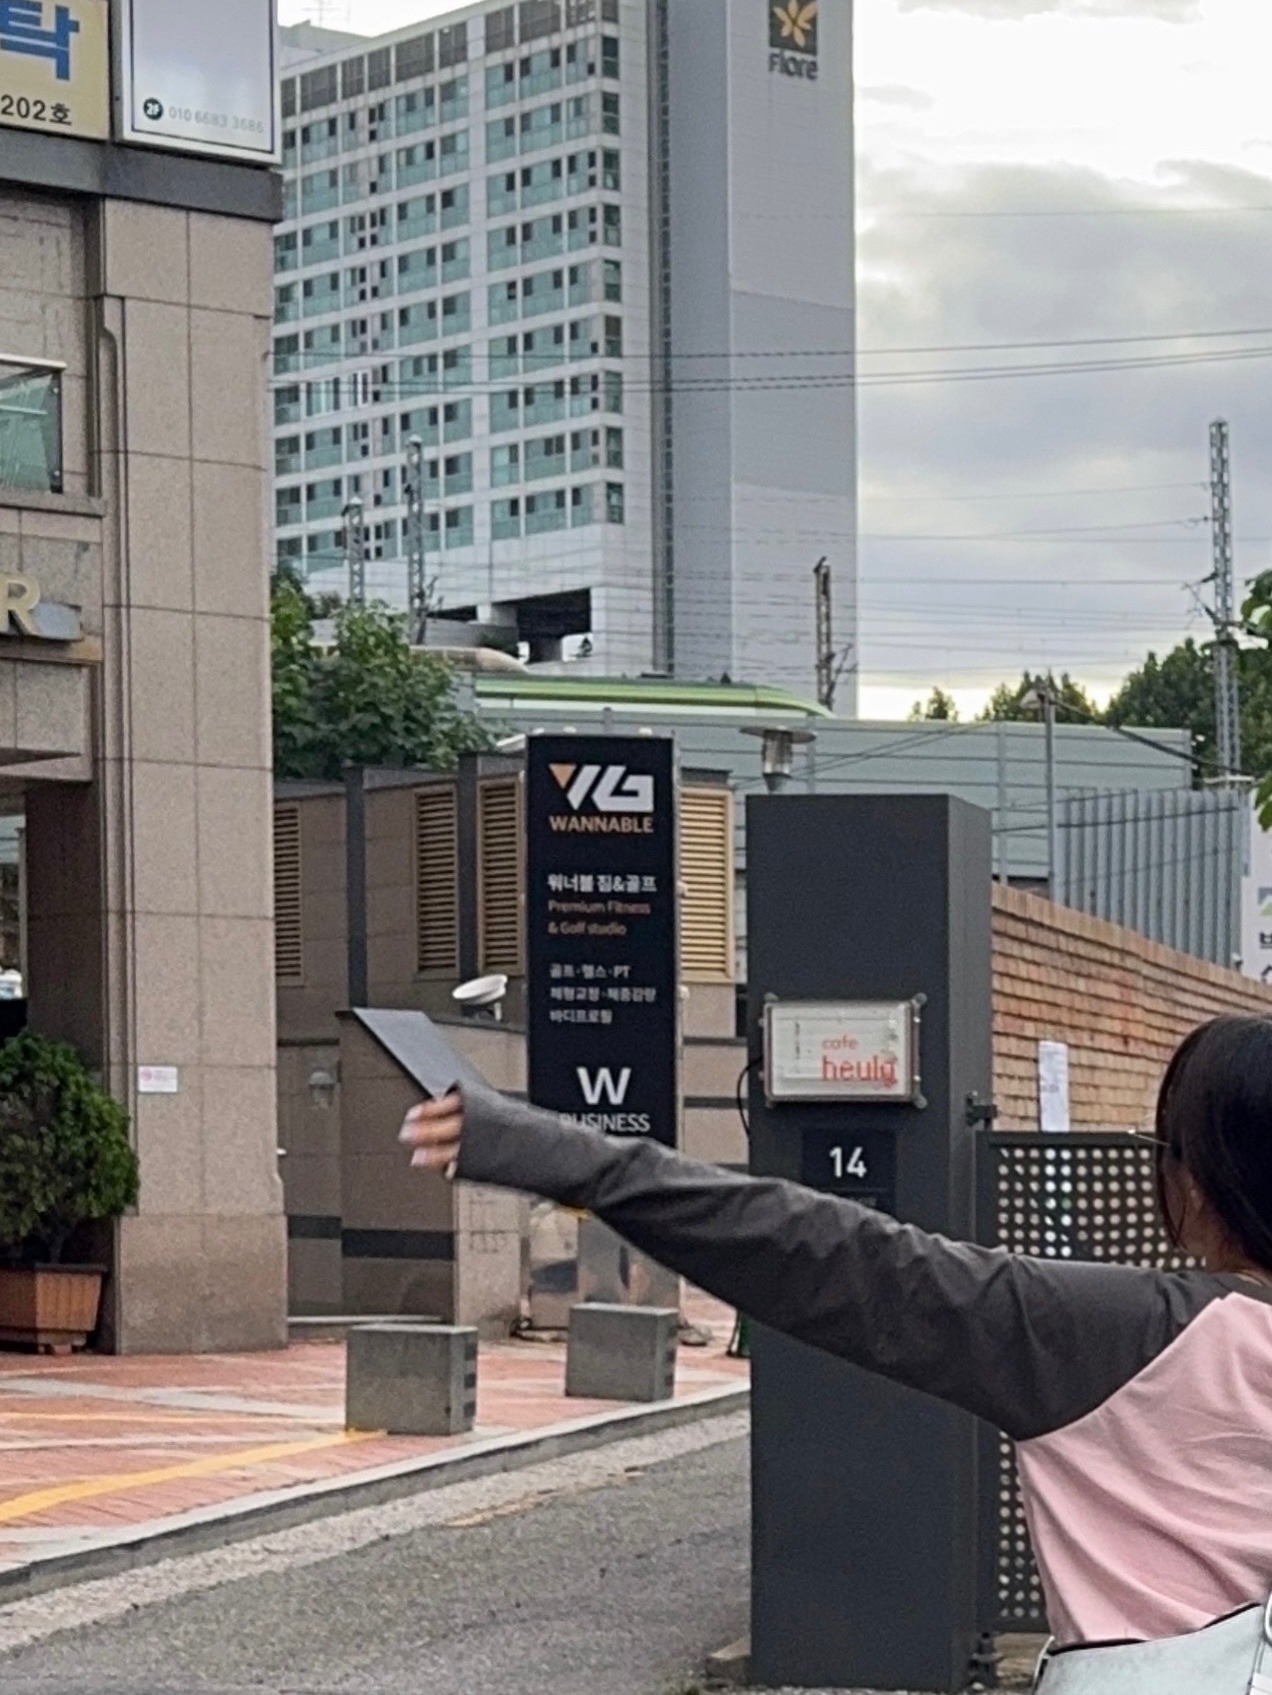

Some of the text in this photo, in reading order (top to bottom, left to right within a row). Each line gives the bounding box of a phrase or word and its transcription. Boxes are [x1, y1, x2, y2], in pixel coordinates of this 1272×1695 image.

[0, 94, 71, 126] 202호
[168, 105, 193, 123] 010
[549, 815, 654, 834] WANNABLE
[547, 873, 594, 893] 워너블
[548, 899, 651, 915] Premium Fitness
[560, 921, 586, 935] Golf
[821, 1034, 859, 1050] cafe
[576, 1066, 632, 1105] W
[829, 1146, 868, 1179] 14
